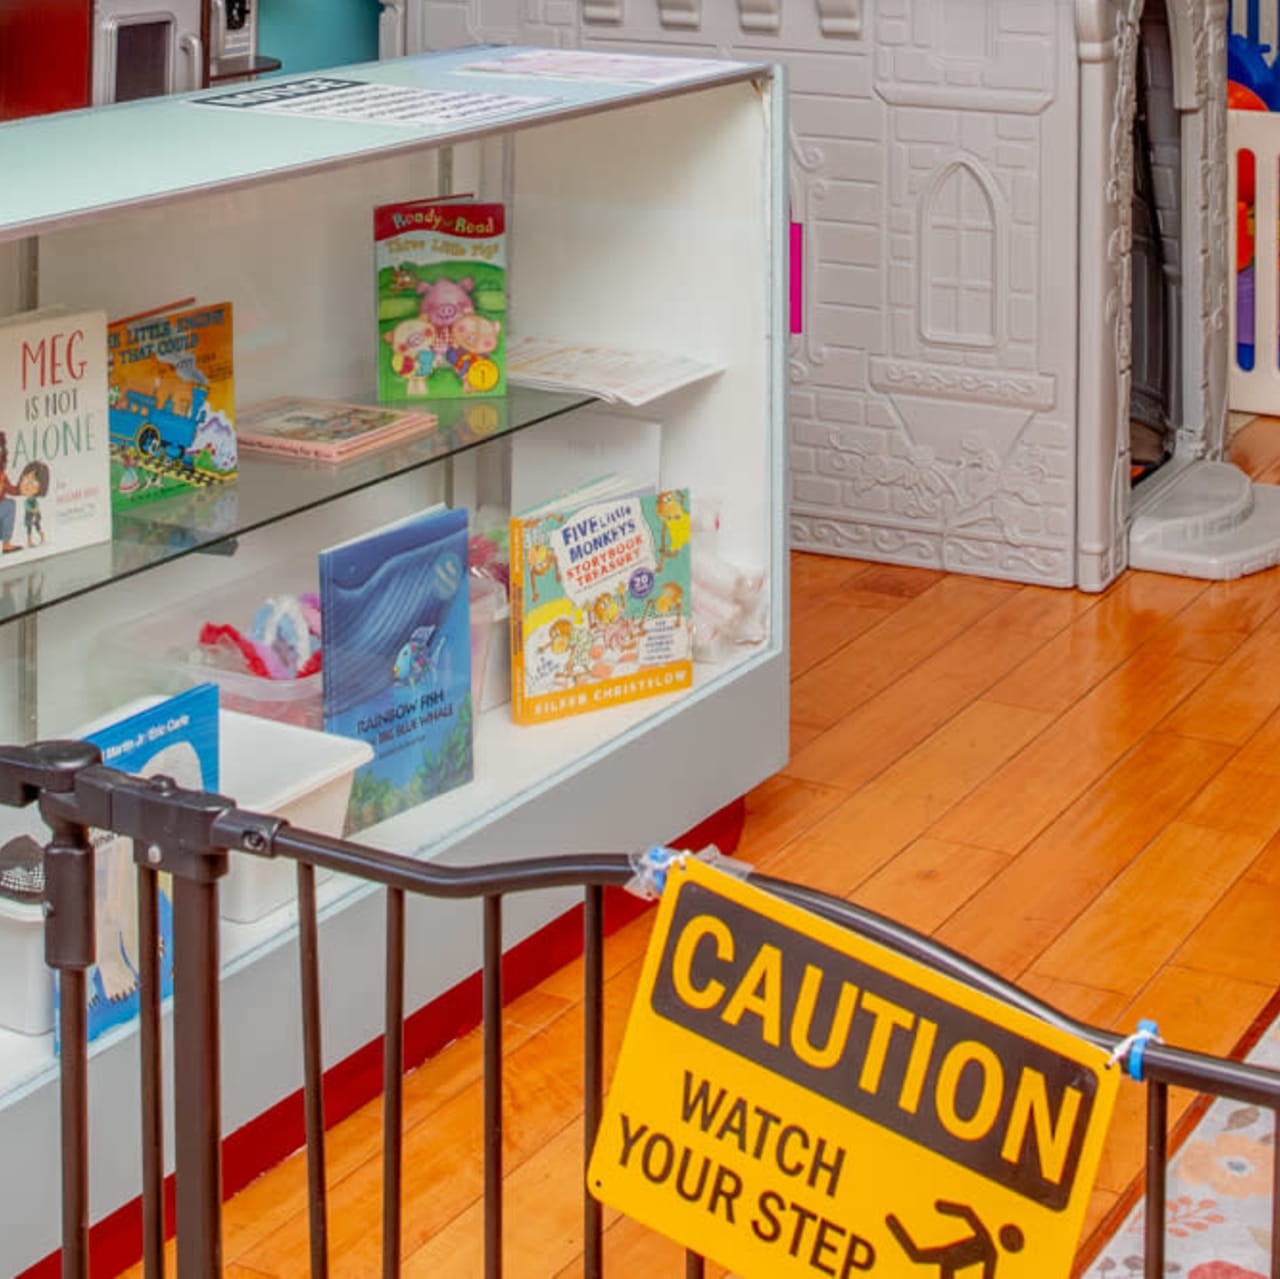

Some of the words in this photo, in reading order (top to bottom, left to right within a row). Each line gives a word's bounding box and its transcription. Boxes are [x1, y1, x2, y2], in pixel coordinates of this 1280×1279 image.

[391, 207, 443, 231] Ready
[455, 216, 495, 234] Read
[384, 237, 426, 255] Three
[430, 238, 466, 257] Little
[470, 241, 500, 260] Pigs
[120, 342, 157, 365] THAT
[157, 332, 200, 357] COULD
[126, 321, 171, 344] LITTLE
[21, 328, 88, 392] MEG
[24, 395, 40, 422] IS
[44, 387, 79, 418] NOT
[11, 411, 95, 470] ALONE
[561, 514, 598, 546] FIVE
[568, 519, 636, 563] MONKEYS
[565, 533, 644, 580] STORYBOOK
[576, 547, 641, 588] TREASURY
[356, 702, 417, 735] RAINBOW
[420, 687, 445, 712] FISH
[534, 694, 588, 716] EILEEN
[592, 669, 688, 703] CHRISTELOW
[395, 719, 417, 737] BLUE
[671, 914, 1084, 1185] CAUTION
[683, 1070, 847, 1198] WATCH
[619, 1113, 744, 1225] YOUR
[751, 1188, 877, 1279] STEP
